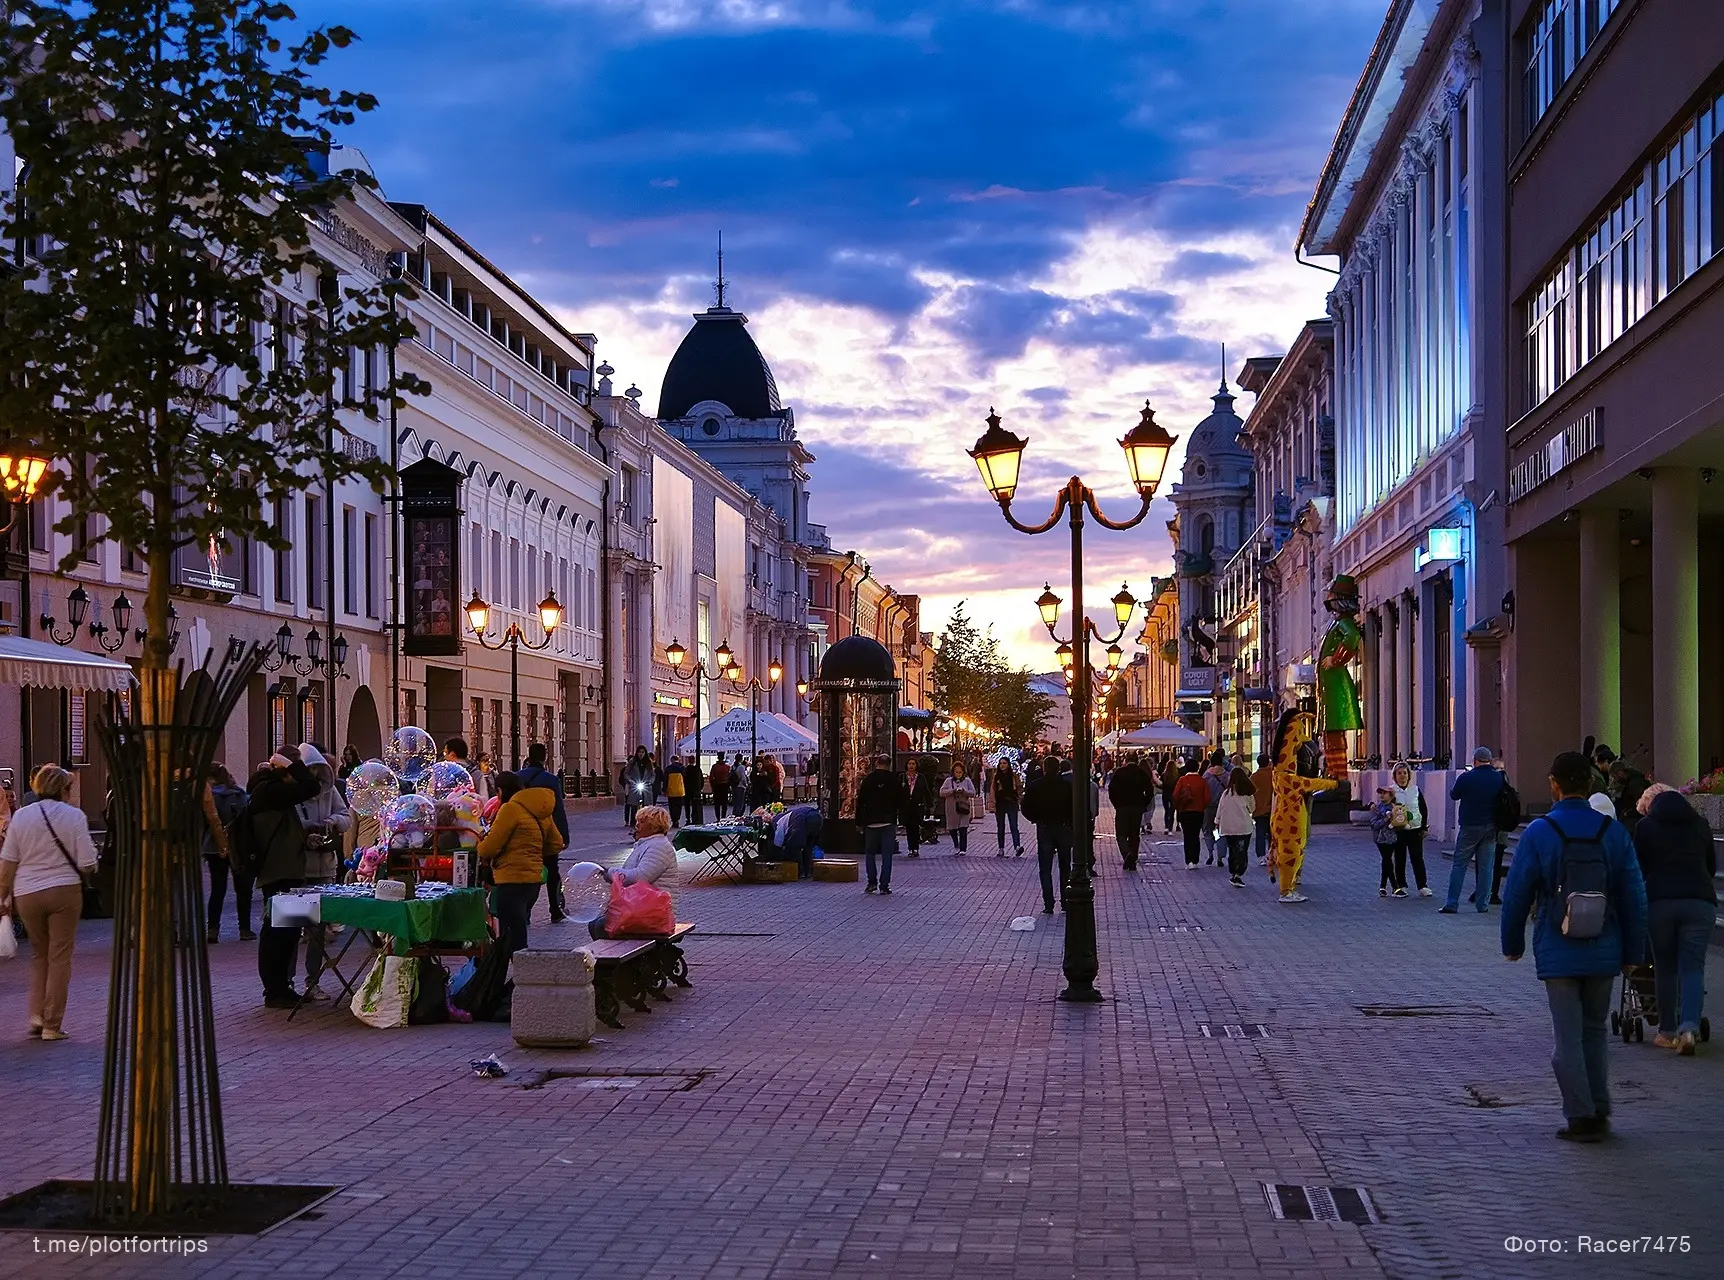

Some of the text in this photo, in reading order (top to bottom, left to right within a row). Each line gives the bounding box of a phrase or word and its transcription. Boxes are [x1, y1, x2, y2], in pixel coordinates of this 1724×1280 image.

[1562, 407, 1597, 468] КНИГИ
[1183, 671, 1209, 679] COYOTE
[726, 719, 753, 727] БЕЛЫЙ
